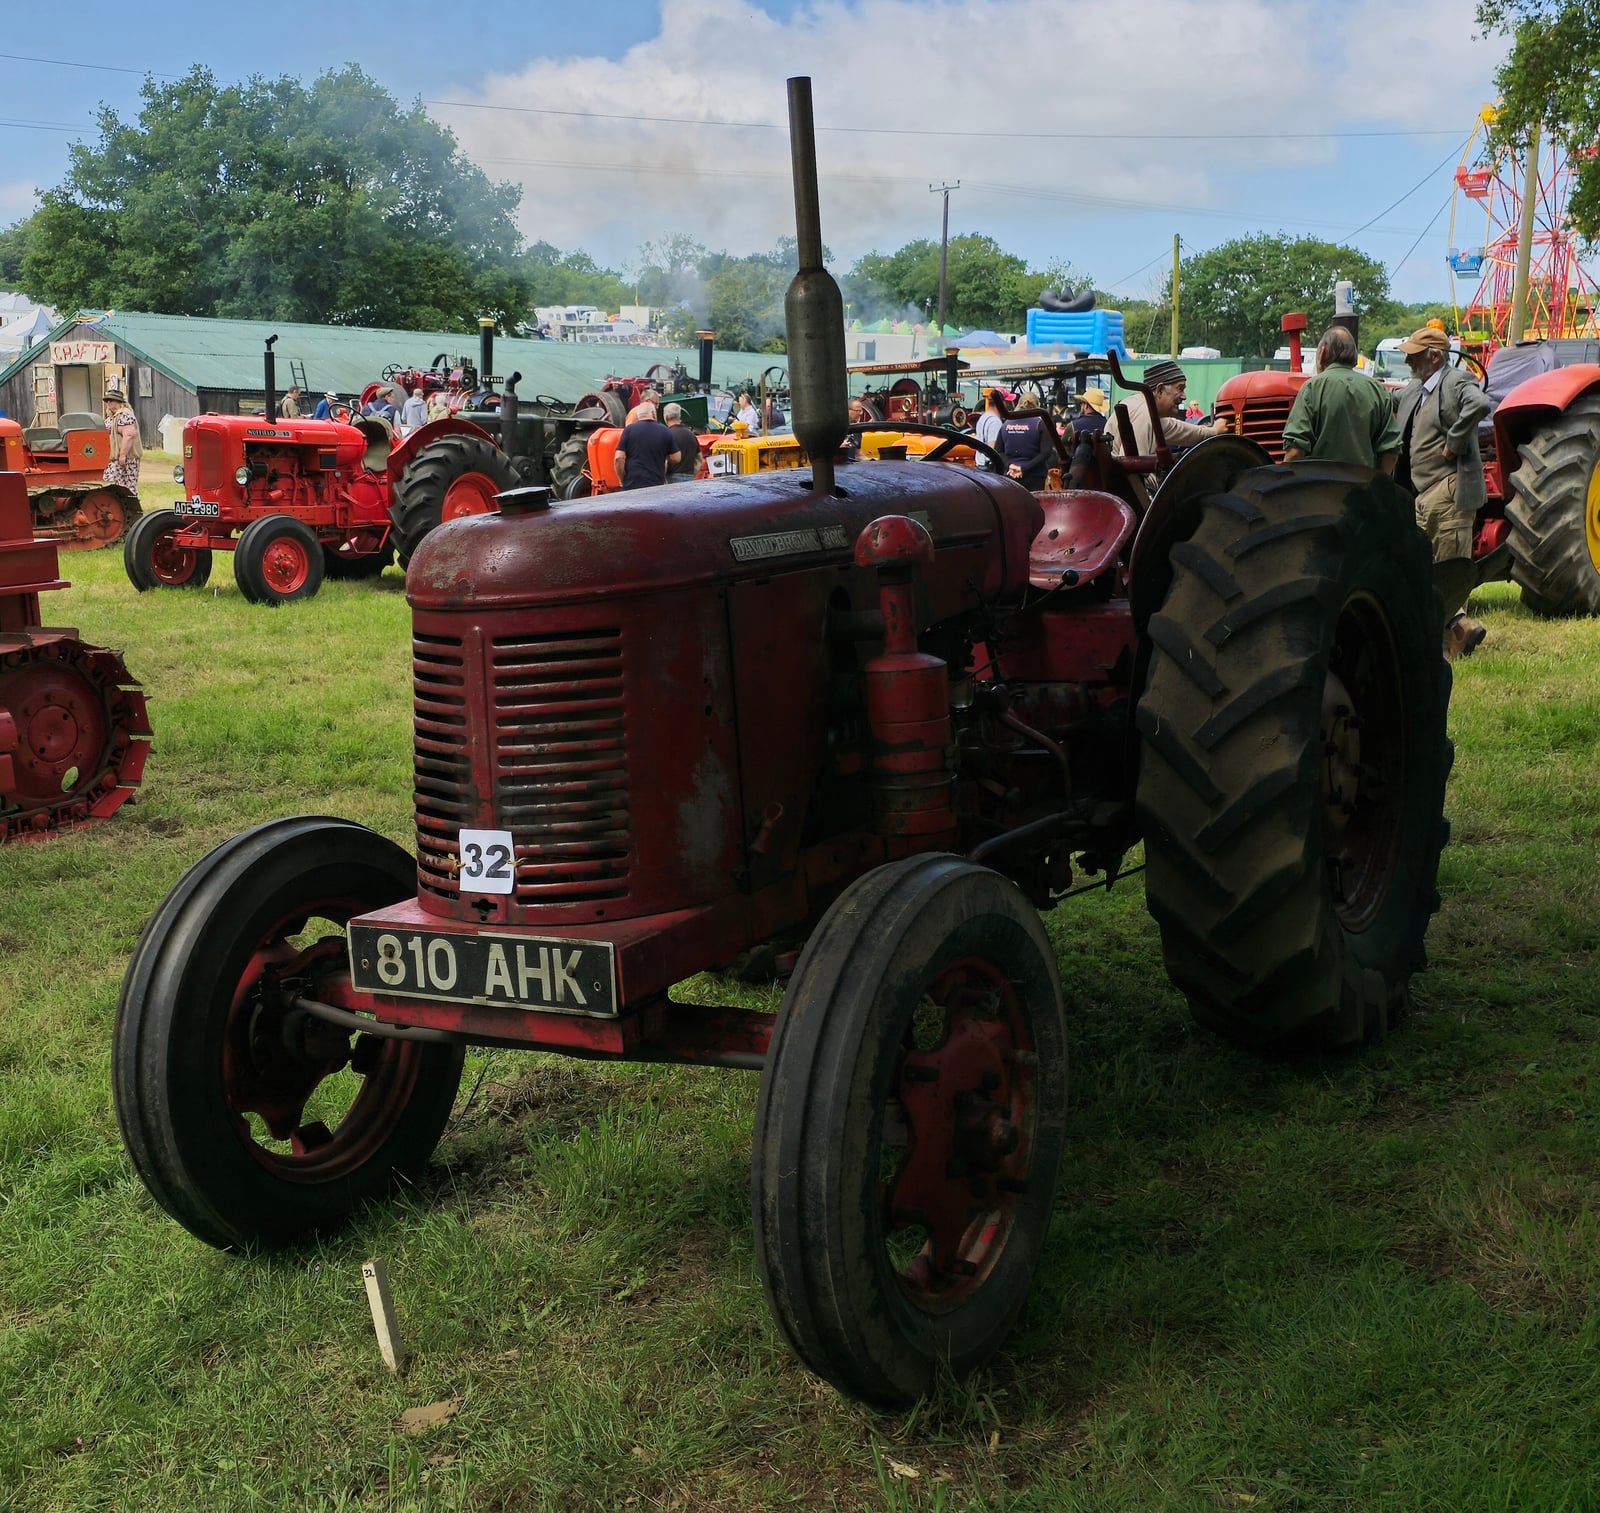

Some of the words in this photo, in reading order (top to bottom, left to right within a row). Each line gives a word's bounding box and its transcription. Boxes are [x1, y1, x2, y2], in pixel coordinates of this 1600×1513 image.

[734, 536, 775, 557] DAVID
[775, 530, 821, 552] BROWN
[464, 843, 511, 879] 32
[376, 934, 458, 992] 810
[485, 943, 587, 1005] AHK
